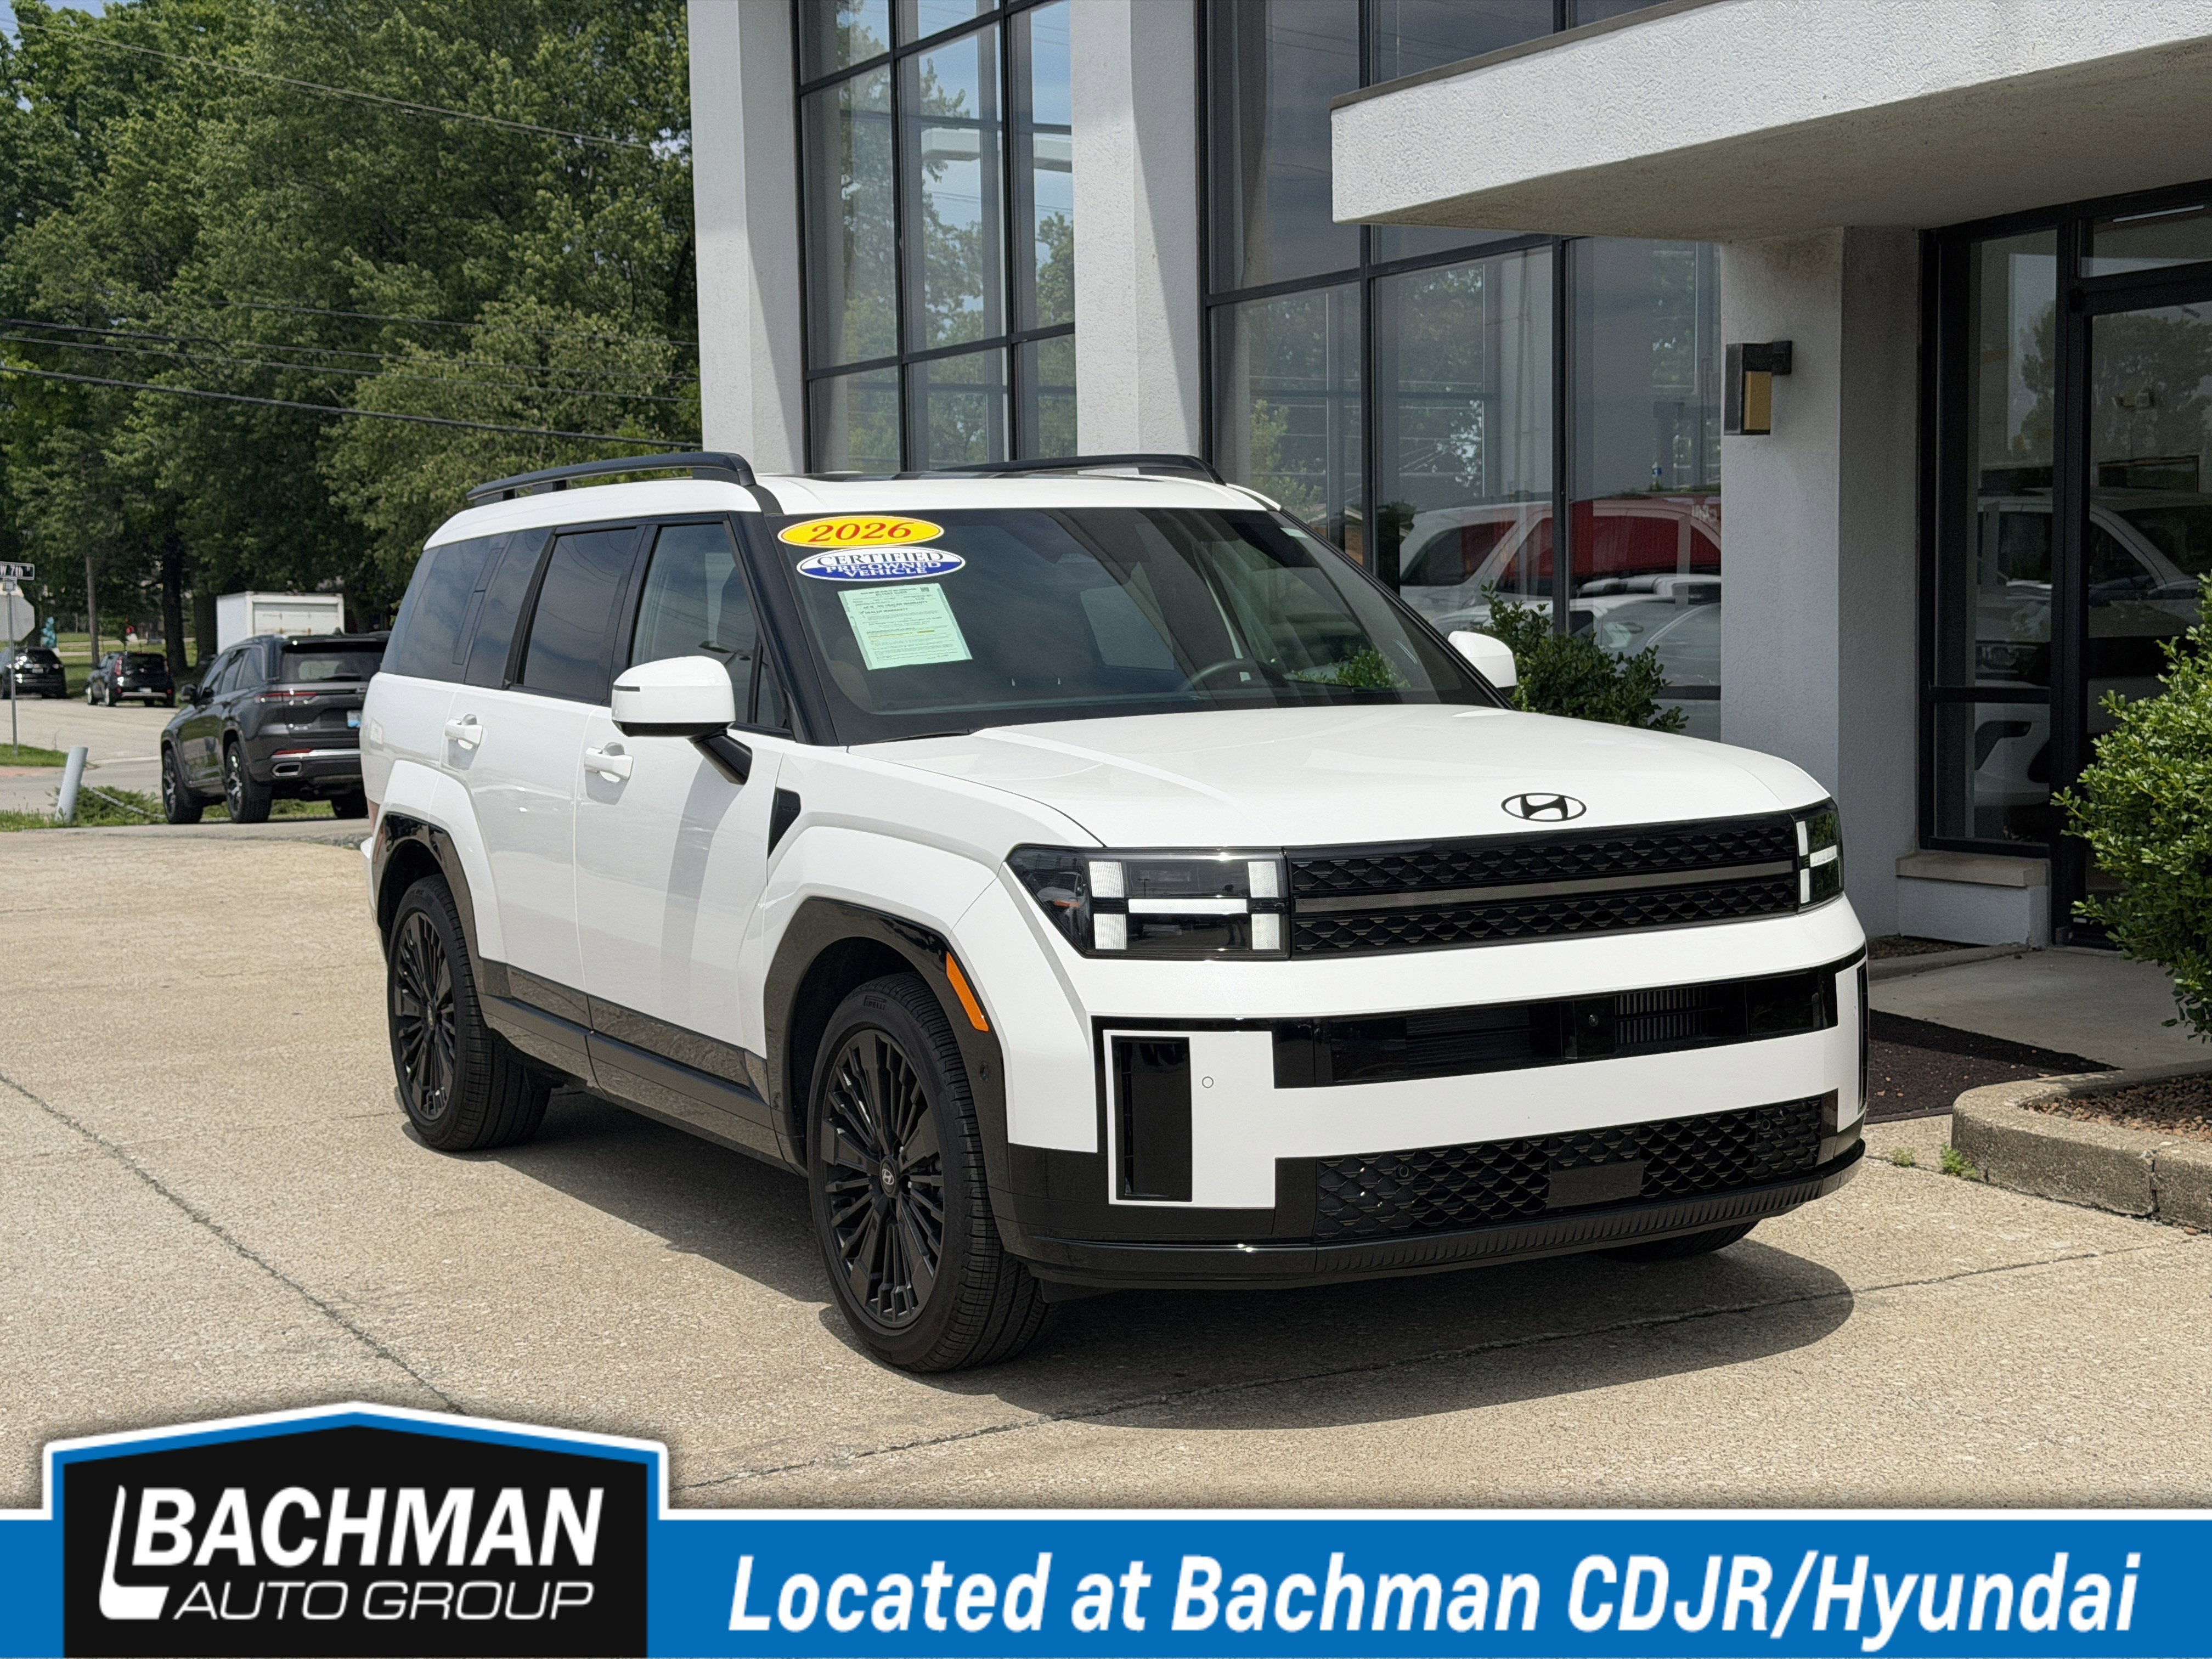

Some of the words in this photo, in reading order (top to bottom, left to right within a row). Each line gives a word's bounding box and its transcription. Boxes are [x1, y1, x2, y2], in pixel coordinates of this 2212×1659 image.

[808, 522, 915, 543] 2026
[817, 551, 944, 567] CERTIFIED
[825, 561, 941, 574] PRE-OWNED
[843, 567, 928, 577] VEHICLE
